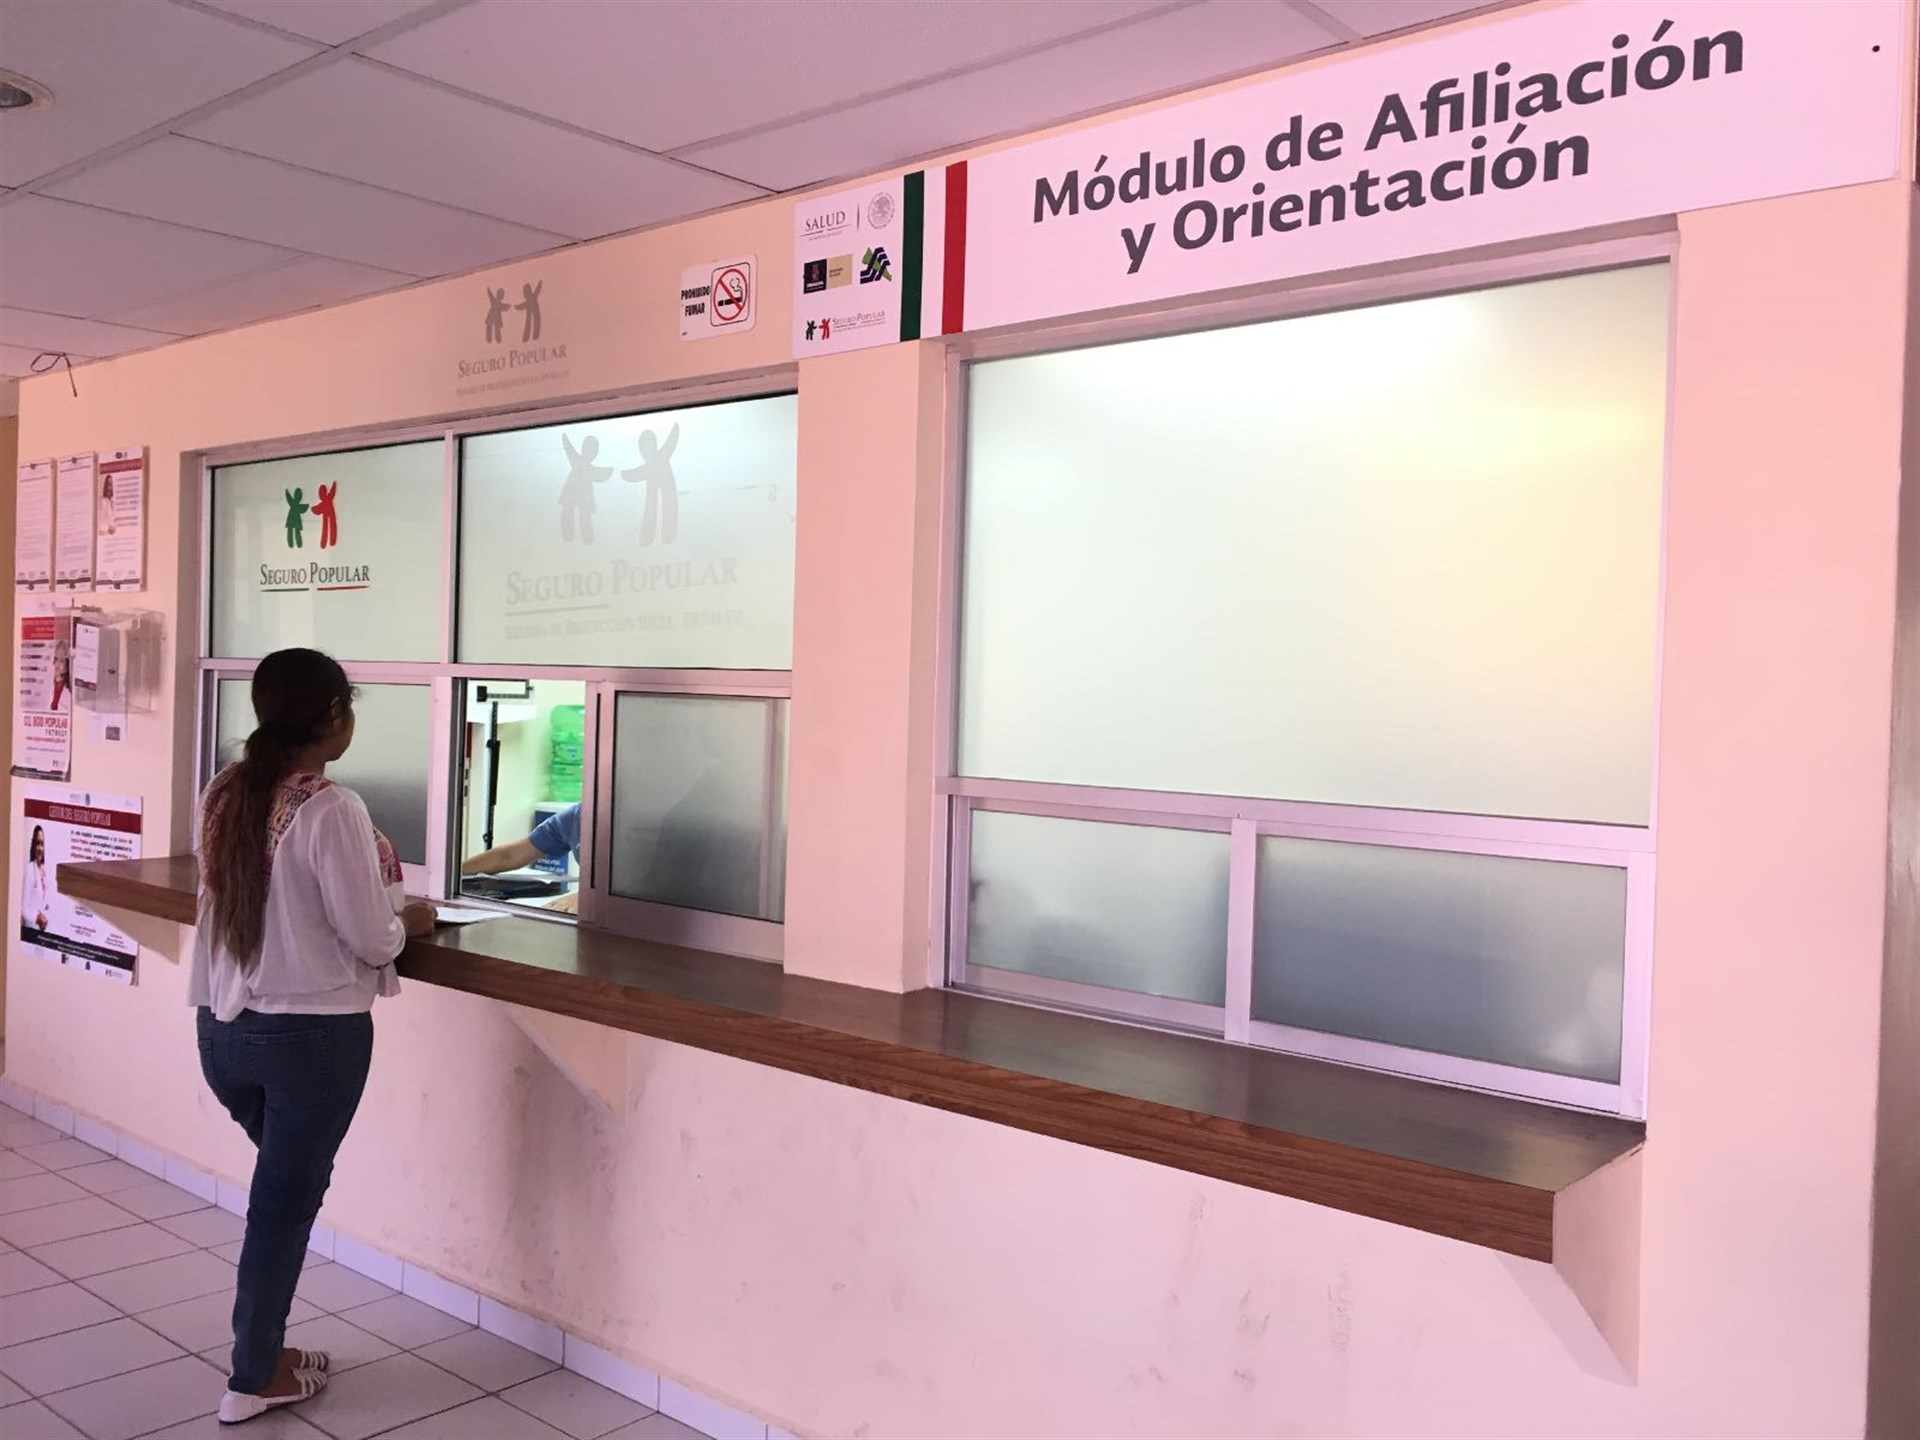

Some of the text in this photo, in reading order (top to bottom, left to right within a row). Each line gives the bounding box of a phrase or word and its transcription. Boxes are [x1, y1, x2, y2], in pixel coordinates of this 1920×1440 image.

[1033, 19, 1744, 224] Módulo de Afiliación
[1121, 122, 1589, 275] y Orientación
[805, 210, 846, 232] SALUD
[681, 285, 711, 301] PROHIBIDO
[685, 302, 705, 317] FUMAR
[457, 343, 568, 379] SEGURO POPULAR
[260, 561, 371, 585] SEGURO POPULAR
[506, 557, 739, 606] SEGURO POPULAR
